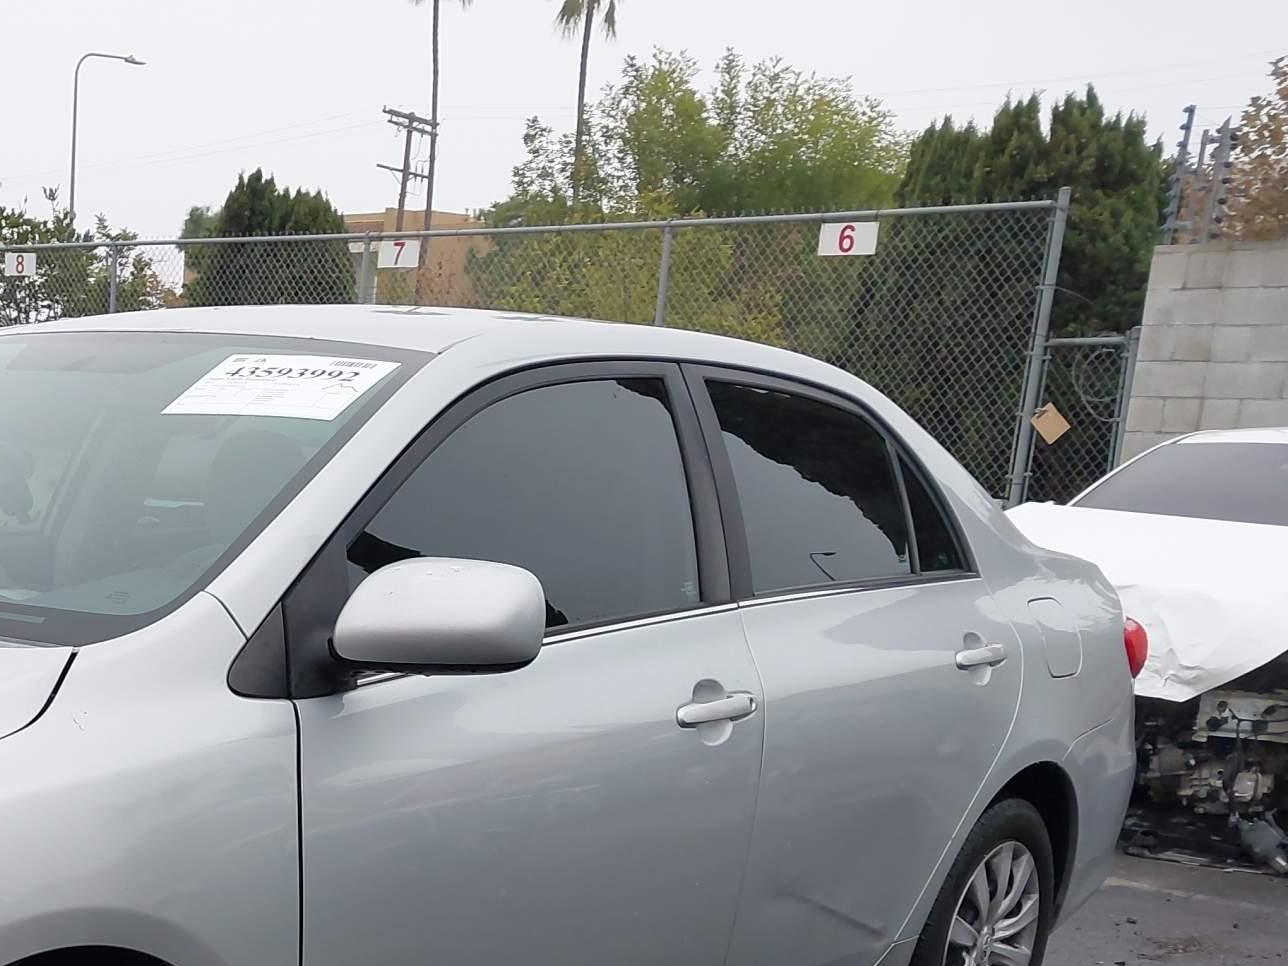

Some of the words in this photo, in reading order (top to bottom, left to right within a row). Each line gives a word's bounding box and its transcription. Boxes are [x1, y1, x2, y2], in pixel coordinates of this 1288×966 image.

[838, 224, 856, 253] 6
[16, 255, 24, 274] 8
[393, 242, 406, 266] 7
[226, 366, 361, 382] 43593992
